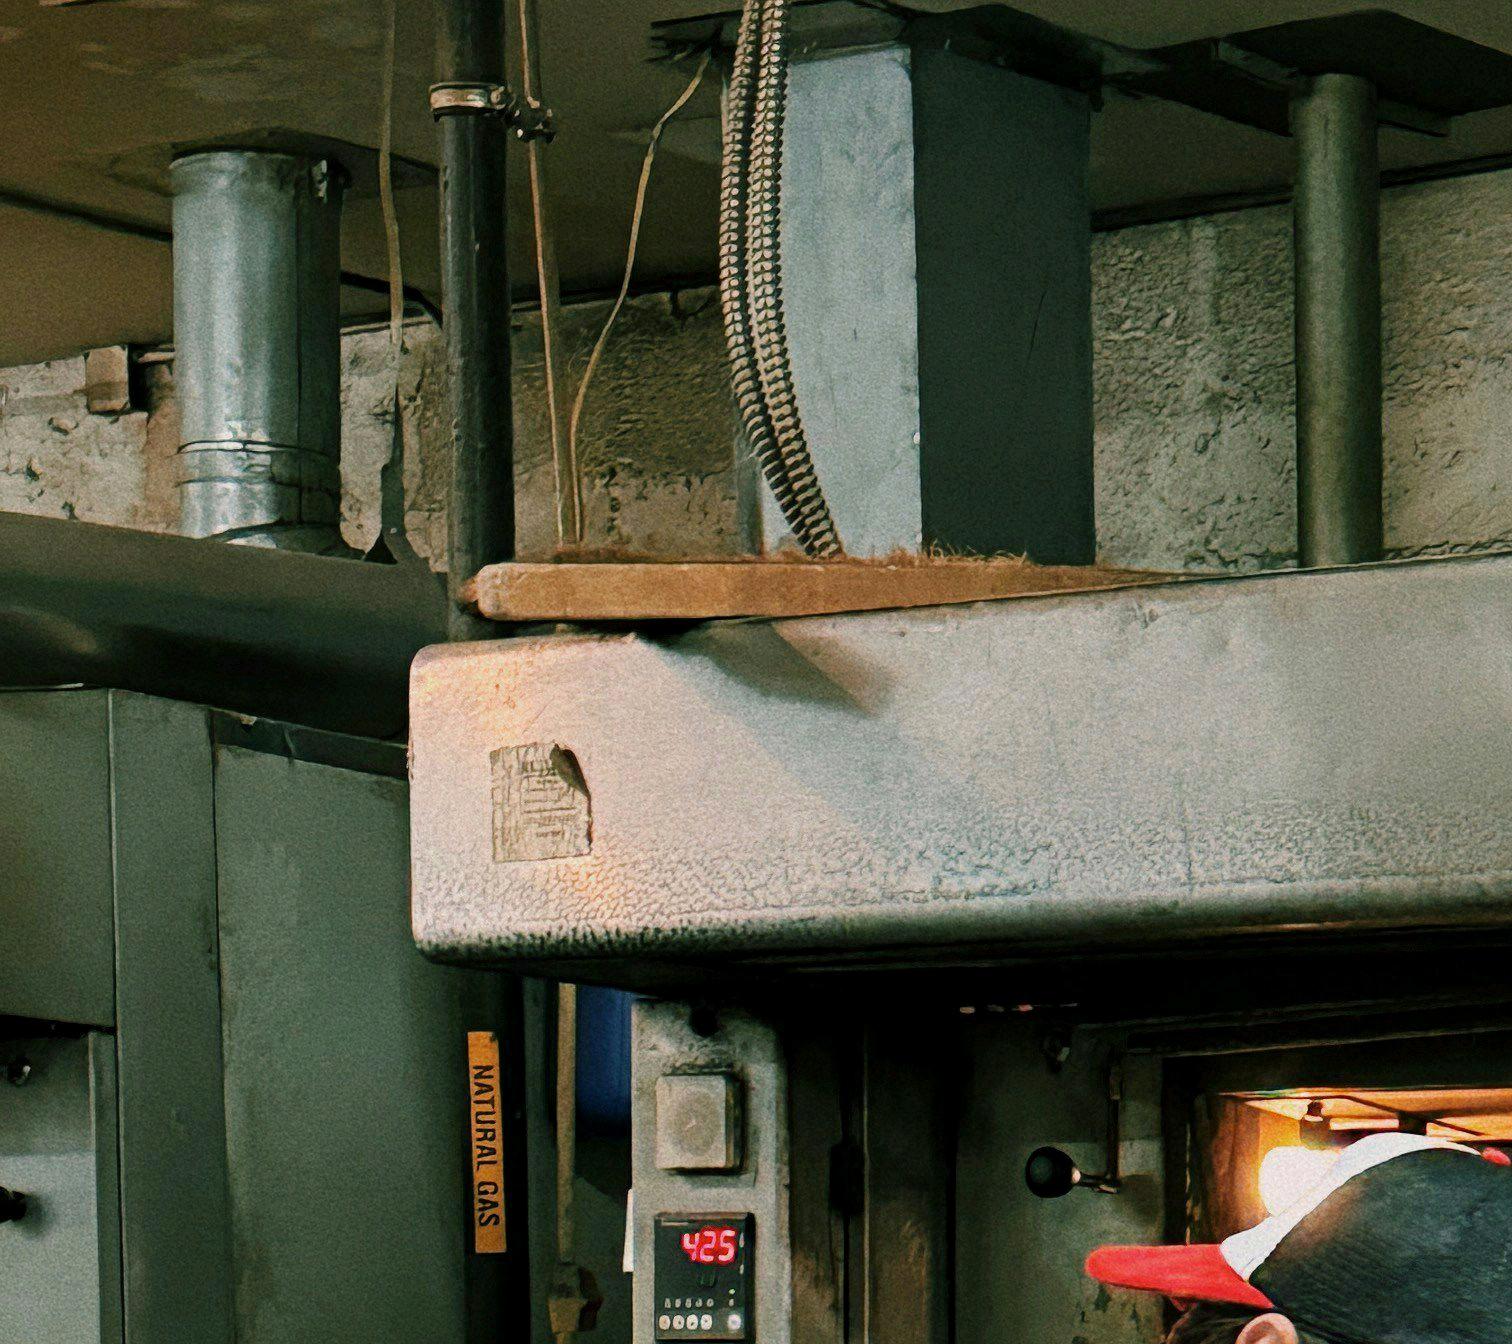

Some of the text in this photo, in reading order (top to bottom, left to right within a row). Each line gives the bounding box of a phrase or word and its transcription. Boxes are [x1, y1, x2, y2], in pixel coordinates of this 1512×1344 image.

[472, 1064, 500, 1227] NATURAL GAS
[682, 1229, 736, 1262] 425
